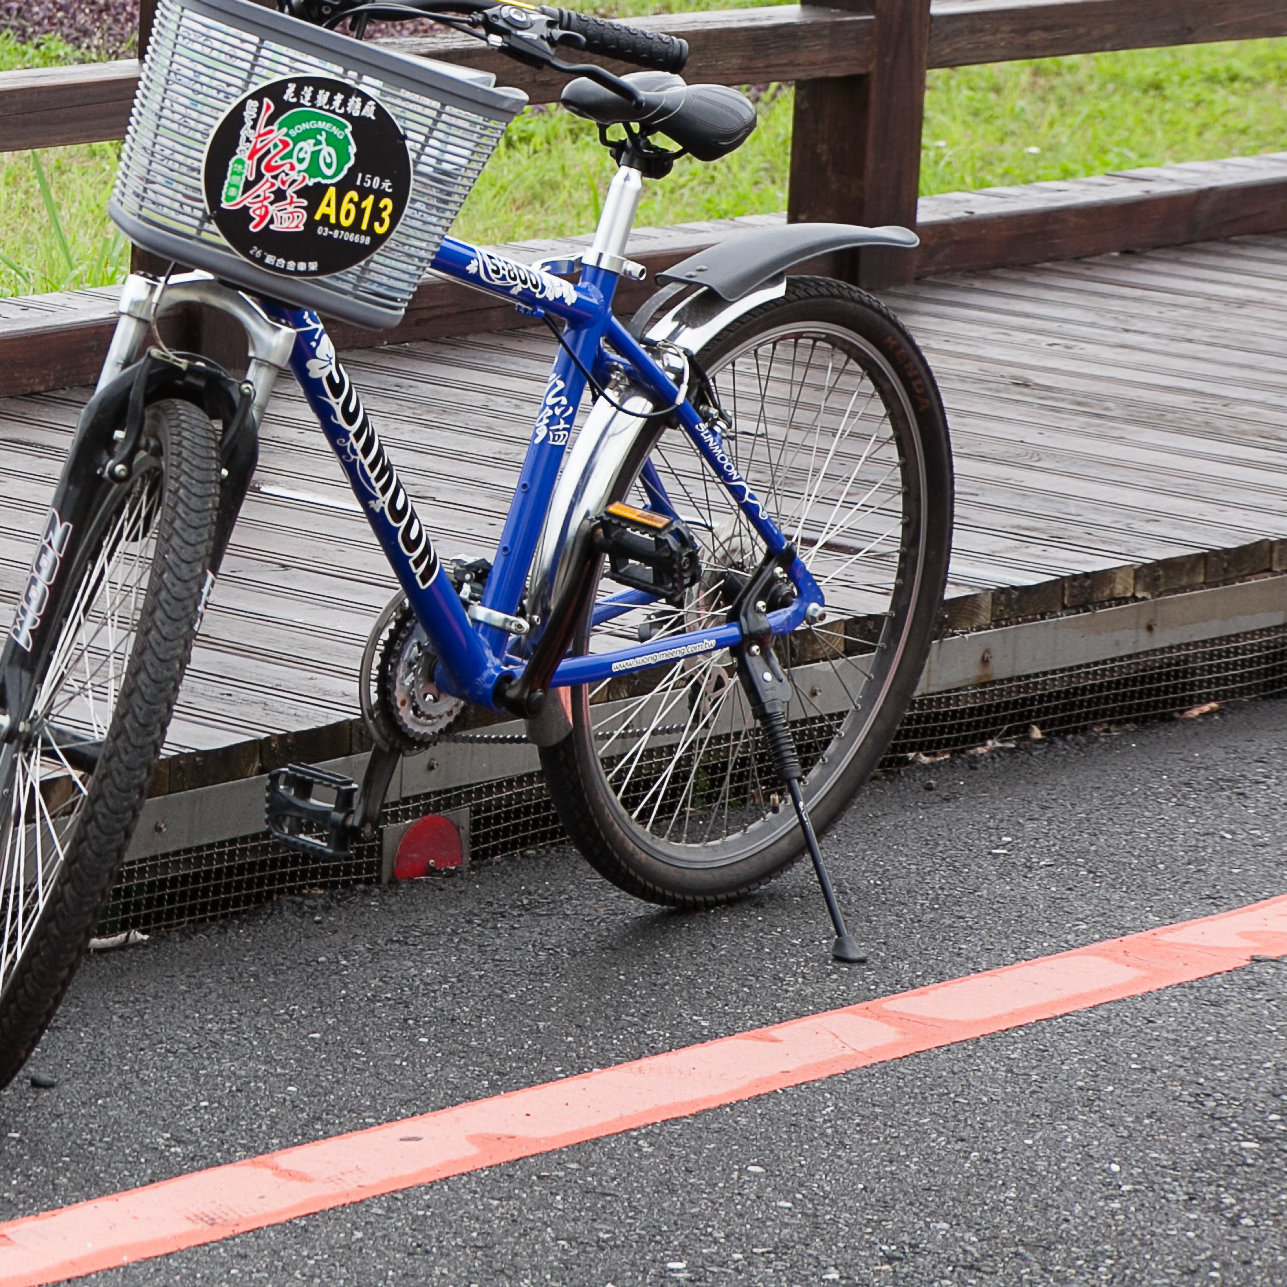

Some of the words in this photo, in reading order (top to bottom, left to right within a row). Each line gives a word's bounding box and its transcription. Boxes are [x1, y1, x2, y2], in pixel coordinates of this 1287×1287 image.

[288, 120, 345, 139] SONGMENG
[356, 172, 393, 192] 150元
[314, 186, 393, 234] A613
[316, 226, 371, 245] 03-8706698
[695, 422, 741, 480] SUNMOON
[10, 507, 73, 652] ZOOM
